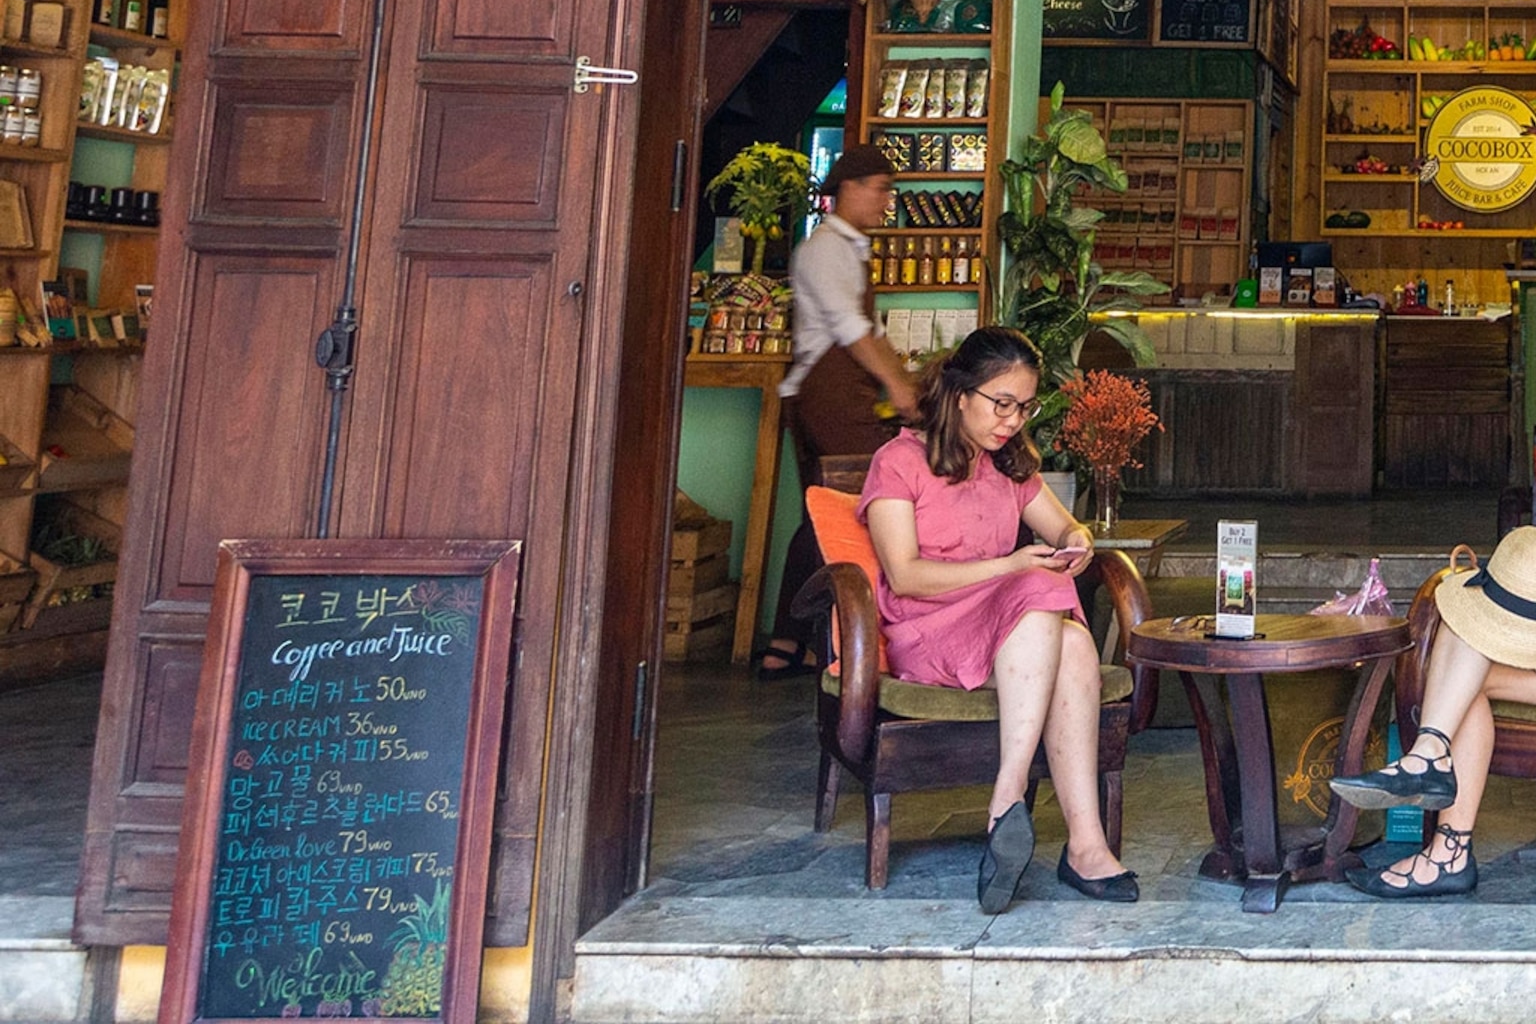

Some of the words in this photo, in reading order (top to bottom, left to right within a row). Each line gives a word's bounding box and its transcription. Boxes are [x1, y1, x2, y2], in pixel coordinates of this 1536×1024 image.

[1213, 24, 1245, 40] FREE
[1458, 96, 1487, 112] FARM
[1490, 96, 1517, 111] SHOP
[1438, 140, 1533, 158] COCOBOX
[1446, 179, 1472, 201] JUICE
[1473, 194, 1493, 204] BAR
[271, 640, 345, 682] Coffee
[389, 626, 452, 662] Juice
